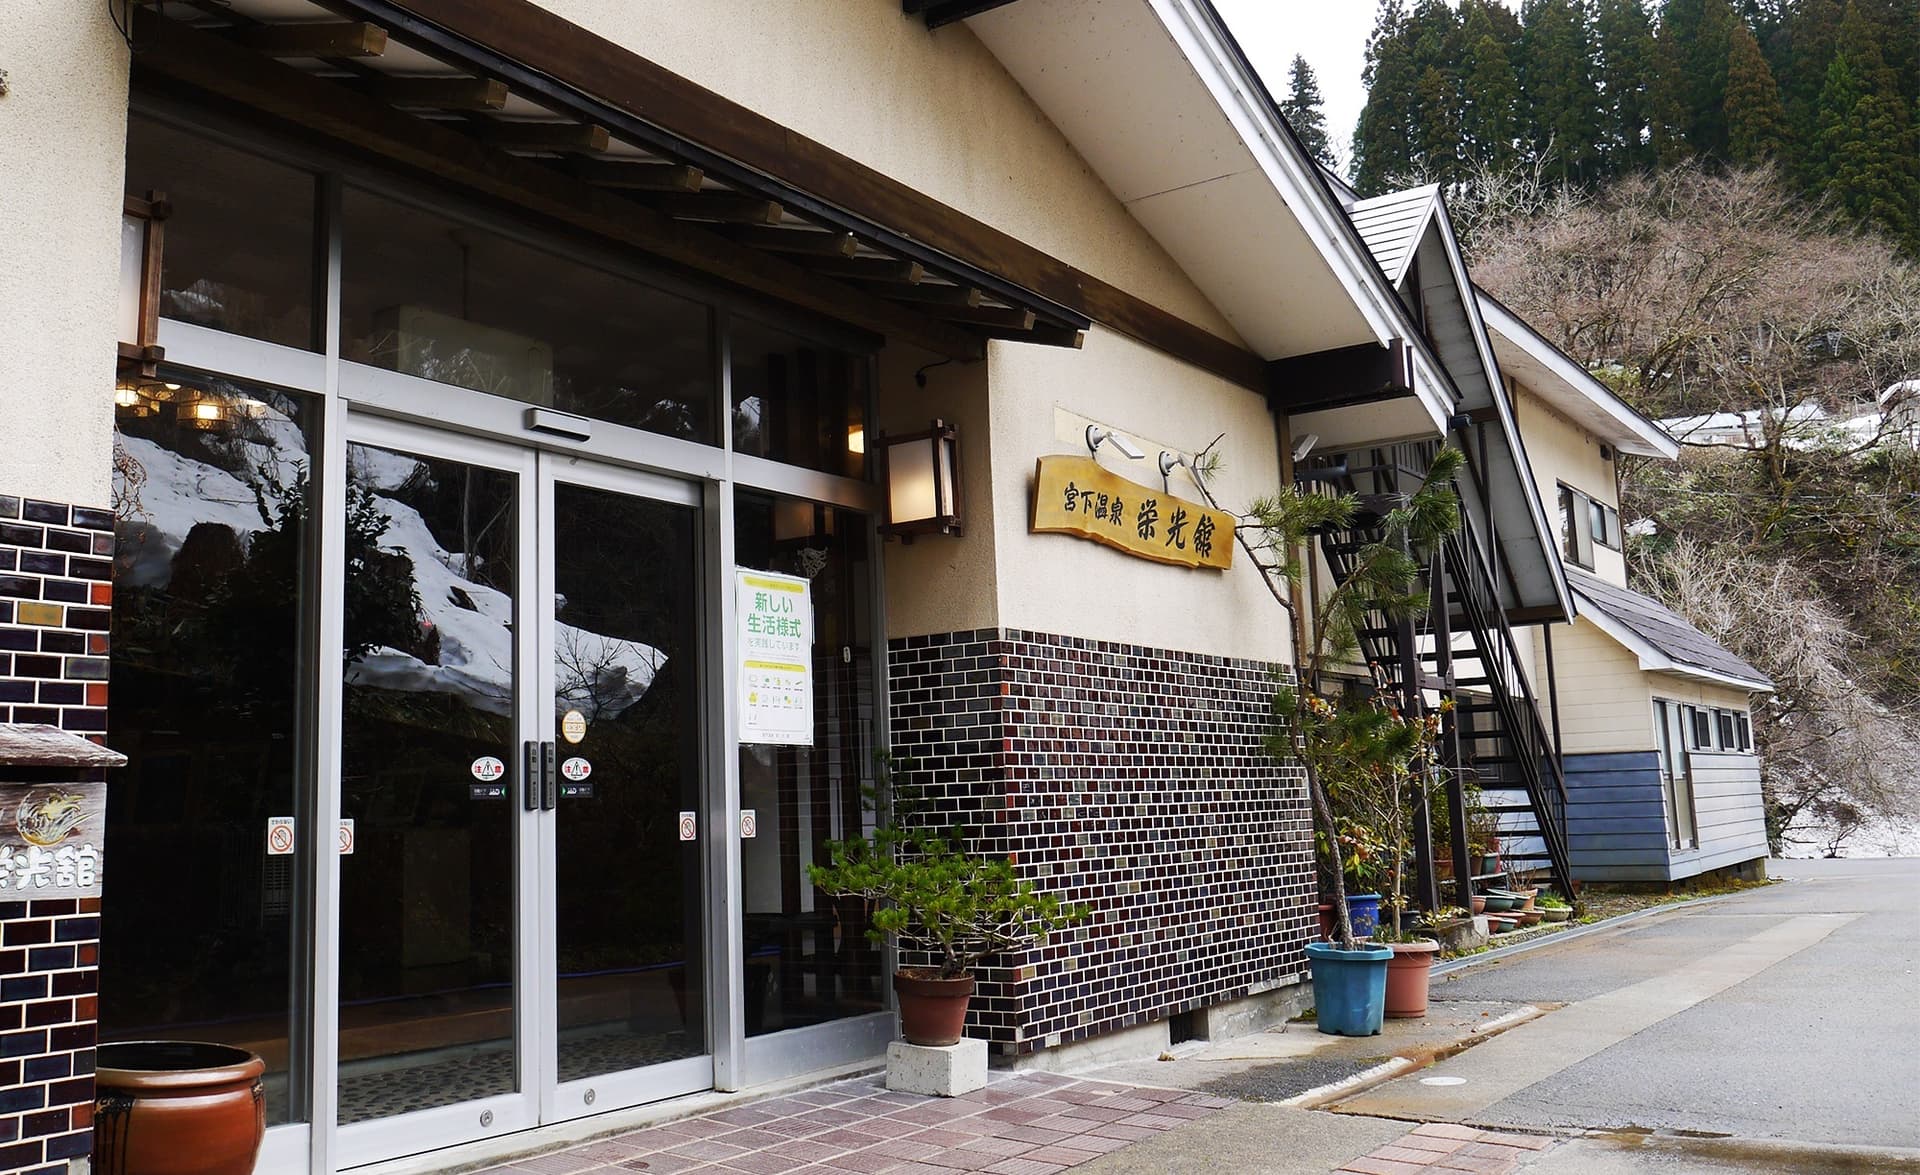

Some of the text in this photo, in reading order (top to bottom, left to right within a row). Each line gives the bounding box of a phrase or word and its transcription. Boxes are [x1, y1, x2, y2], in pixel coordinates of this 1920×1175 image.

[1063, 481, 1124, 527] 宮下温泉
[754, 591, 794, 613] 新しい
[747, 612, 802, 639] 生活様式
